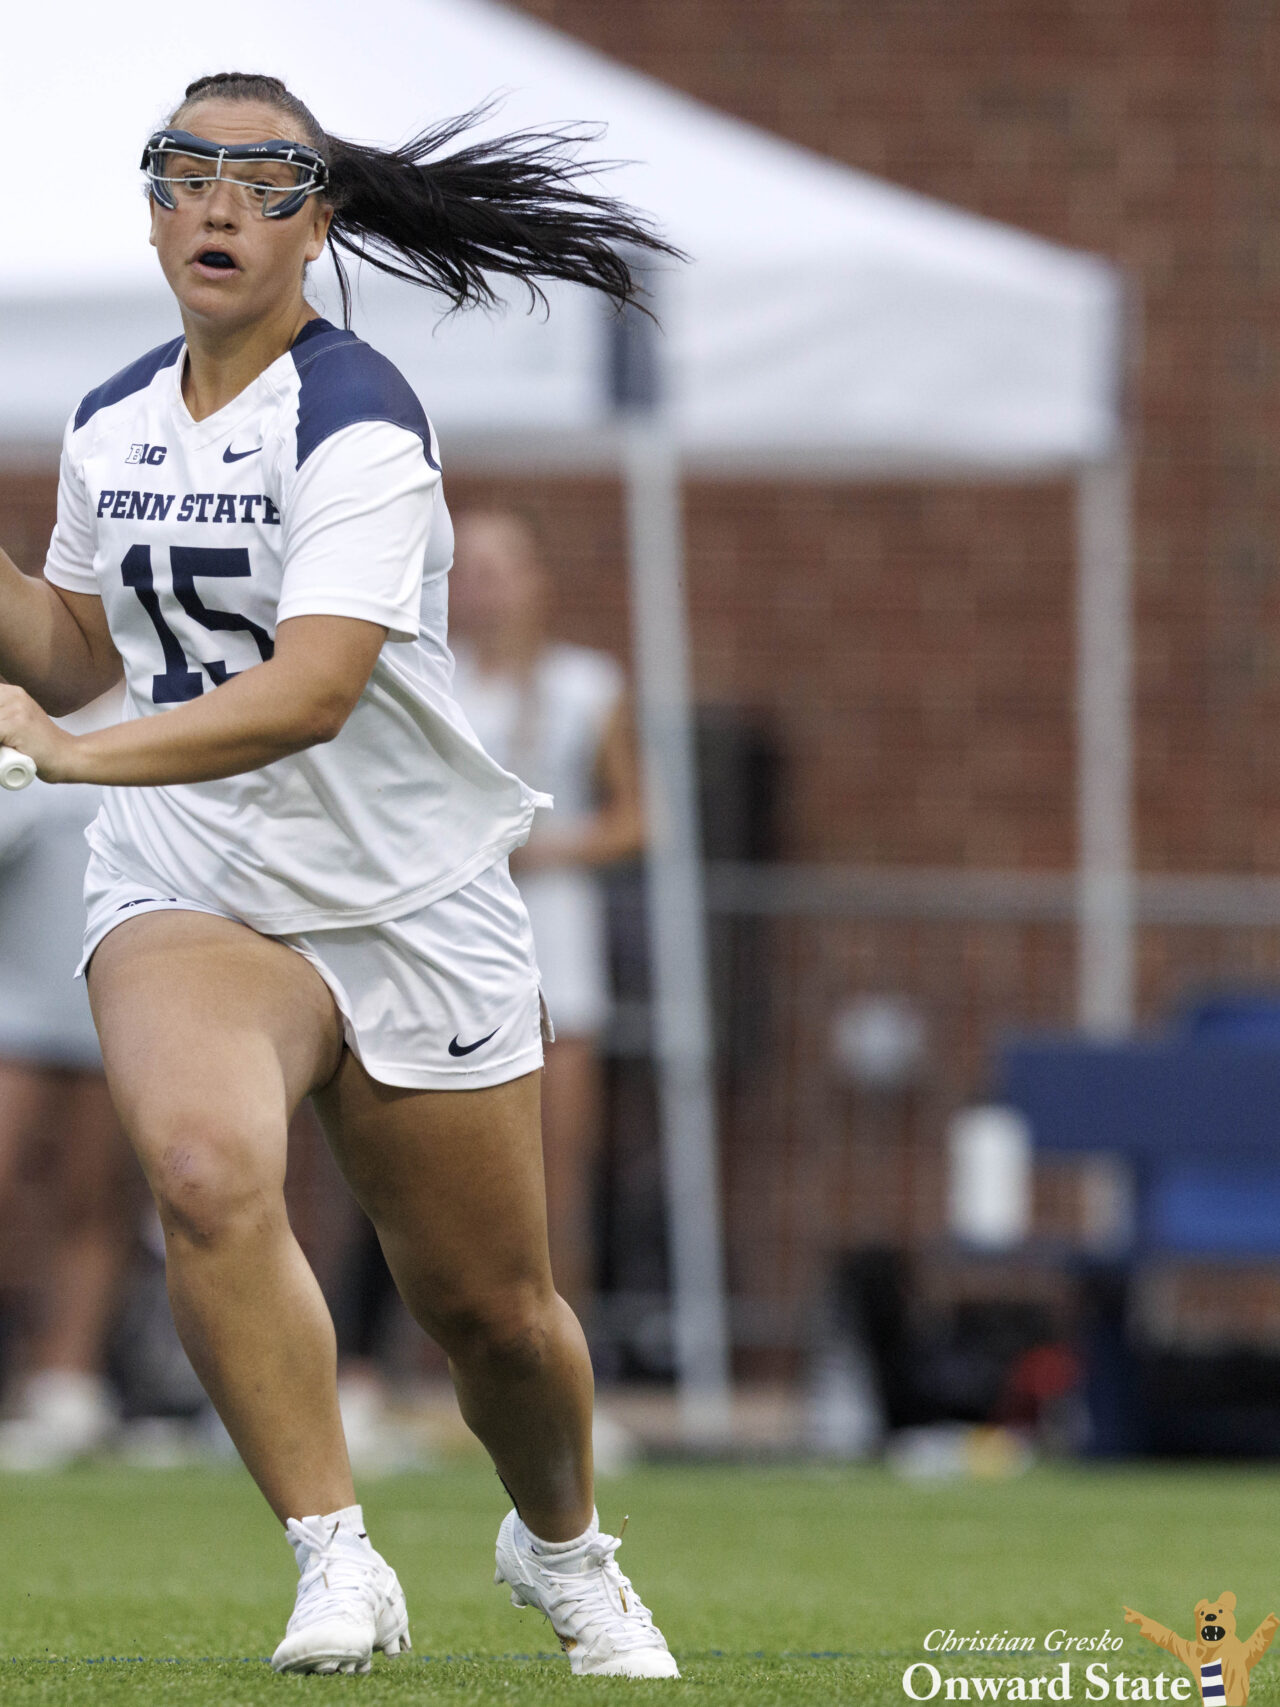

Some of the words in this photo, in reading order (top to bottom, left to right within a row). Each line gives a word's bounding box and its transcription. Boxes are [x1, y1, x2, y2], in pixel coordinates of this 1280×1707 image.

[97, 490, 175, 521] PENN
[176, 493, 280, 525] STATE
[121, 544, 274, 703] 15
